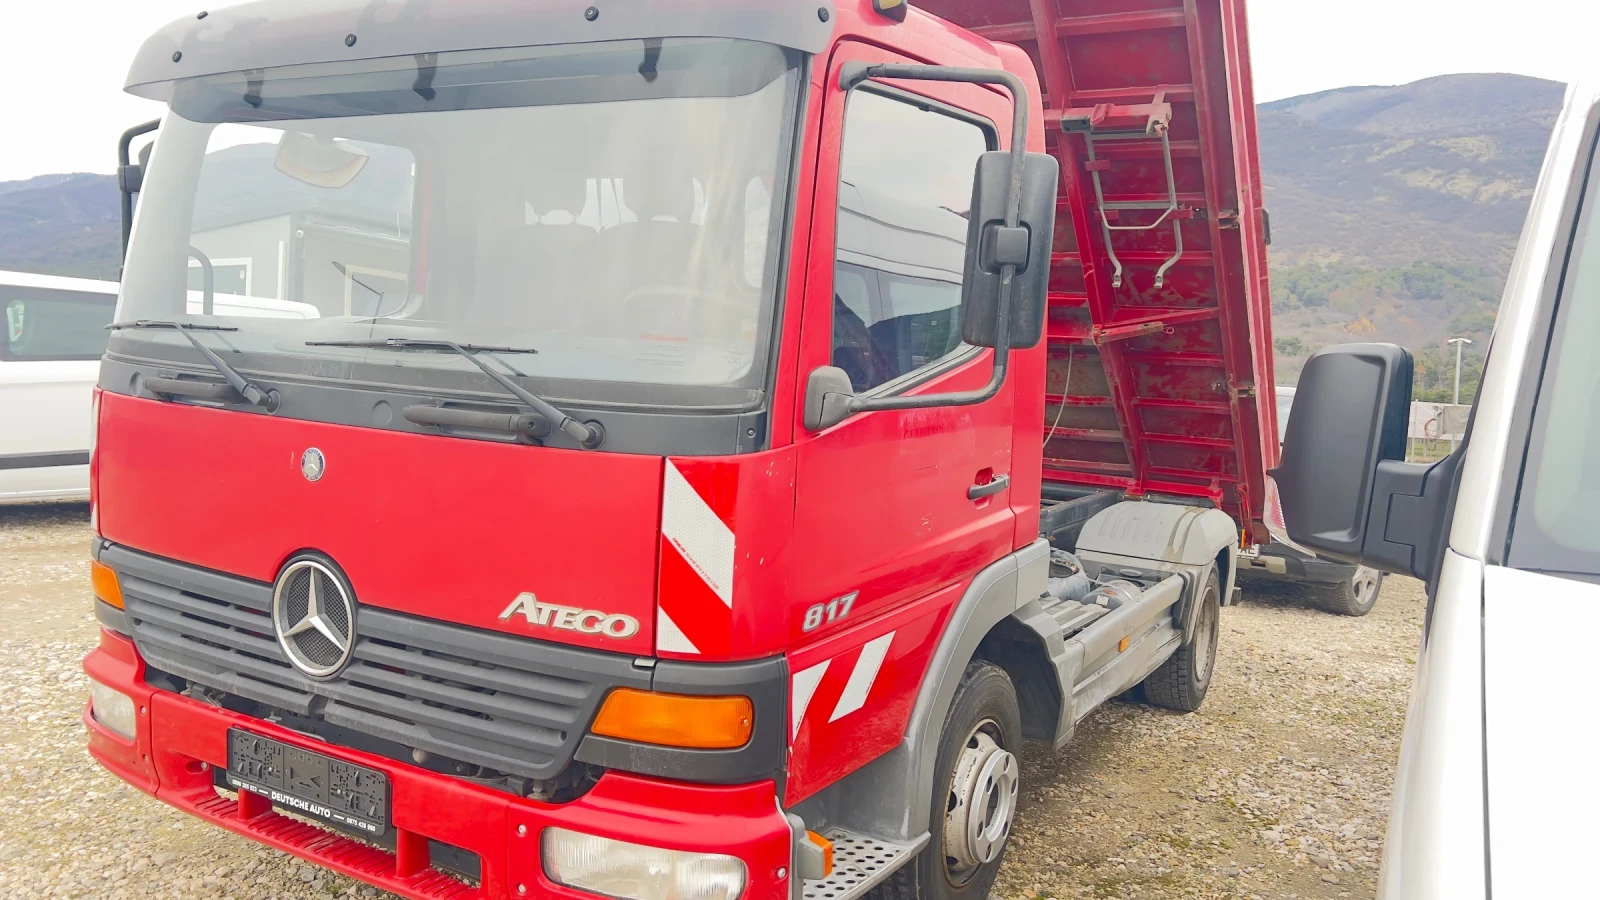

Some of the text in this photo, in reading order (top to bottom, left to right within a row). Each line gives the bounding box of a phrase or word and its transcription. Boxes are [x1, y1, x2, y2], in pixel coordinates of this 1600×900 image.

[498, 592, 640, 639] ATEGO
[802, 590, 859, 632] 817
[271, 791, 309, 811] DEUTSCHE
[309, 804, 331, 818] AUTO
